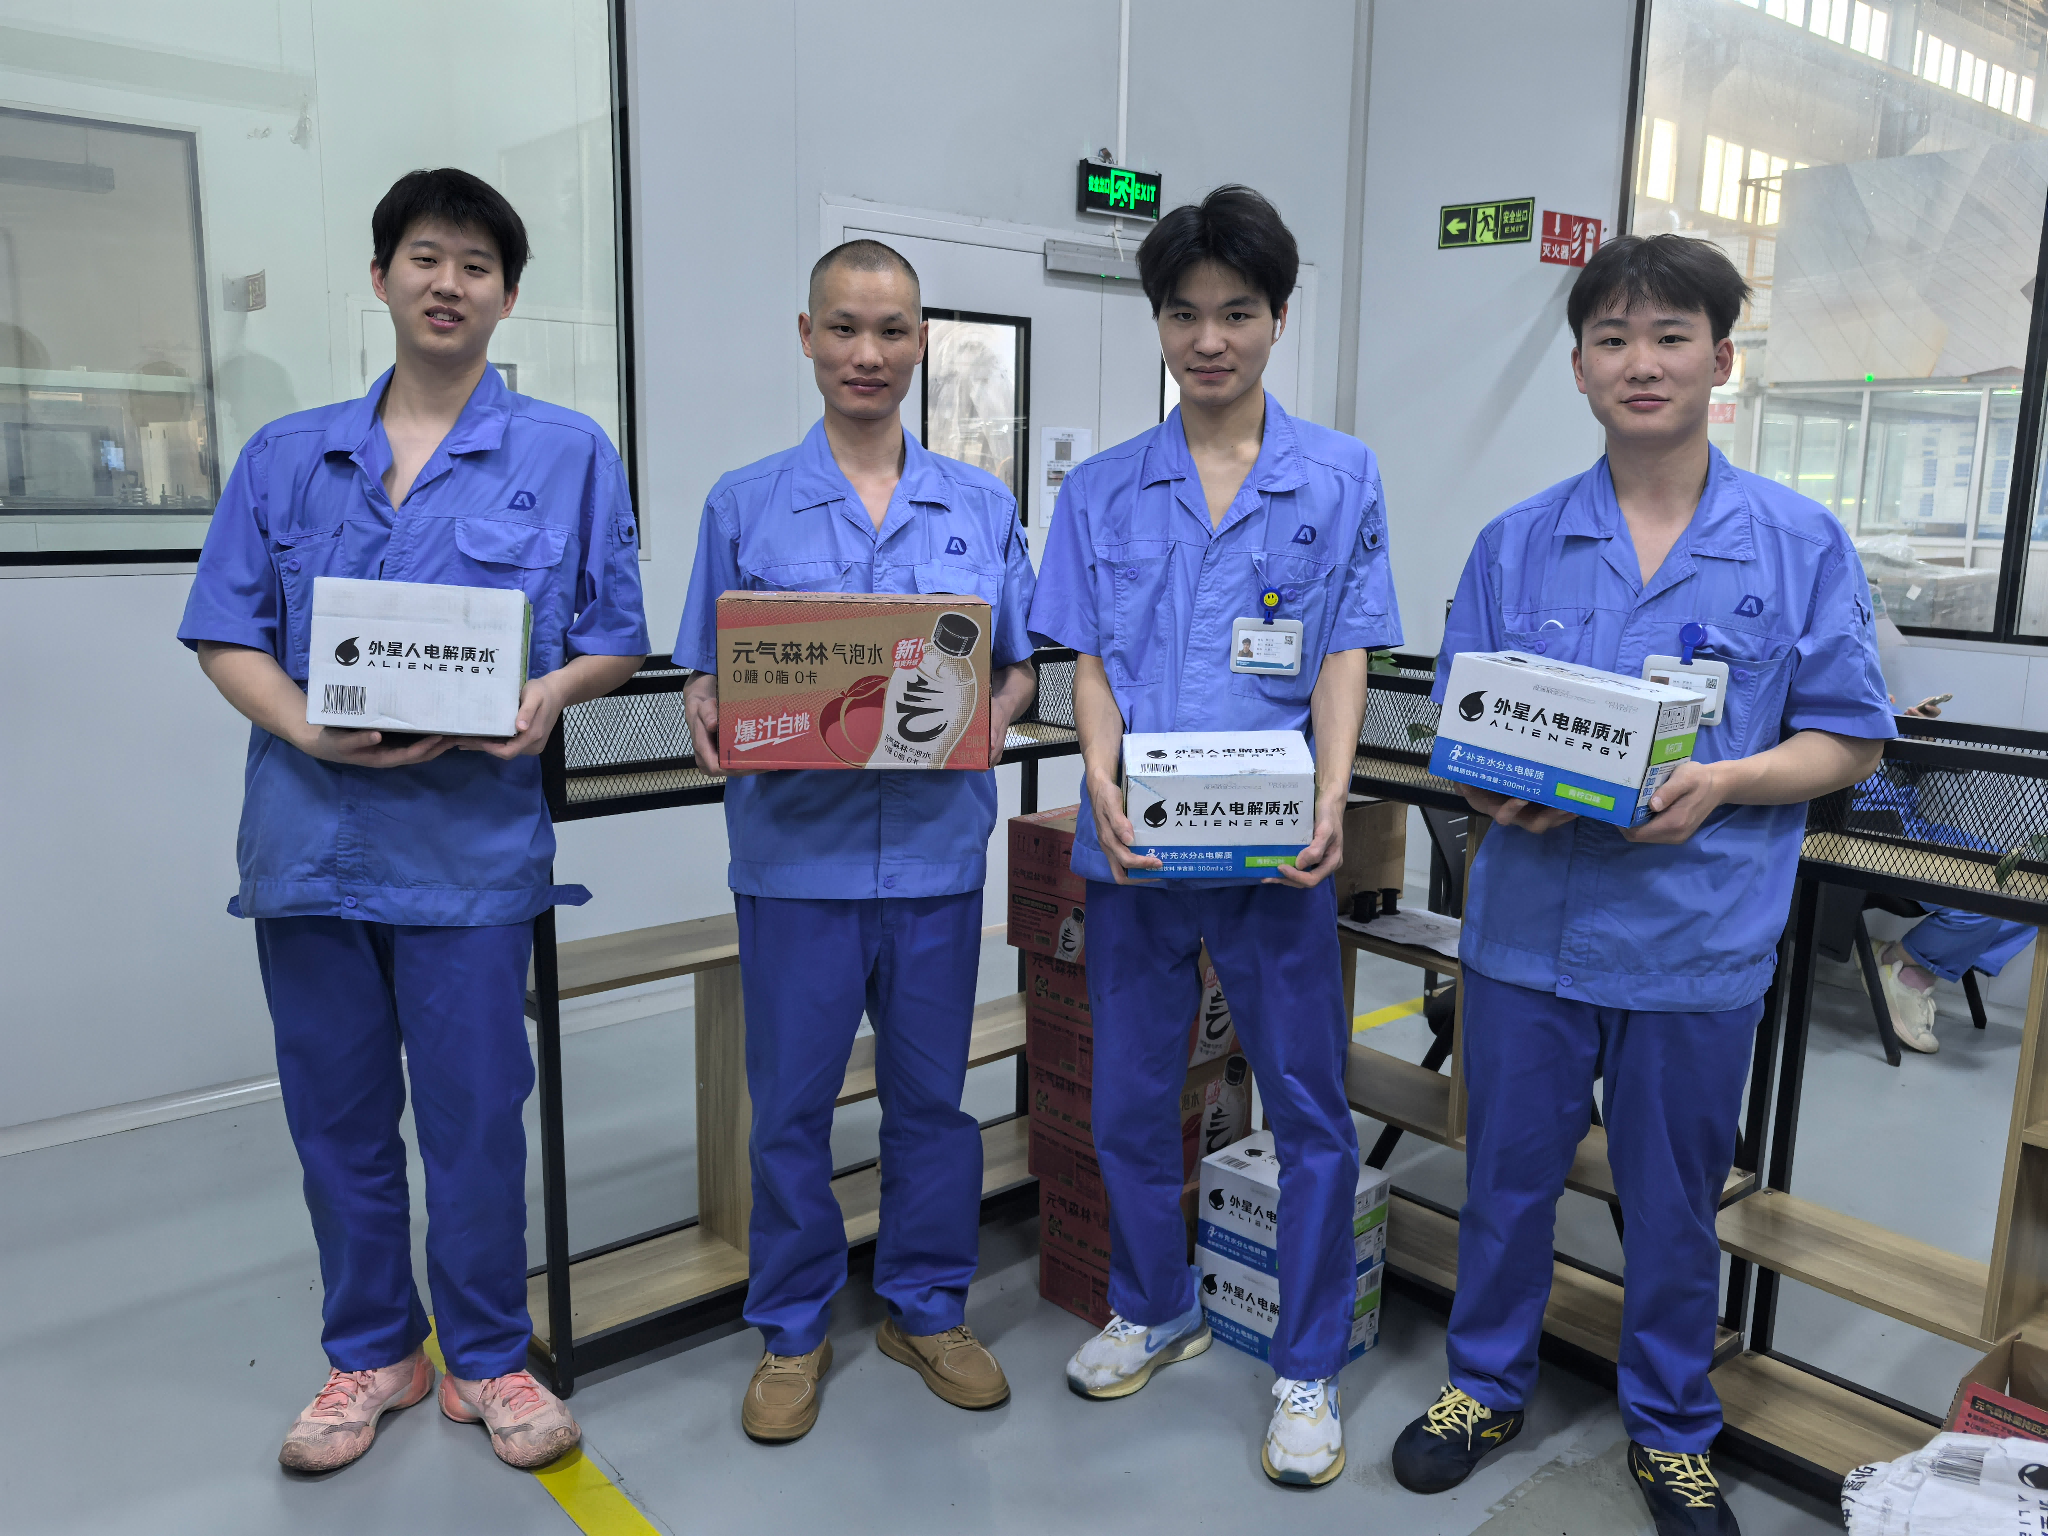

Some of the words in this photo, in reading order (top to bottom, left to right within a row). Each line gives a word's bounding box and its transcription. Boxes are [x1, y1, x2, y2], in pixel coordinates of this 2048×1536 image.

[1135, 183, 1156, 203] EXIT
[1502, 209, 1528, 224] 安全出口
[1504, 224, 1524, 234] EXIT
[1542, 243, 1569, 260] 灭火器
[368, 640, 496, 664] 外星人电解质水
[367, 660, 495, 675] ALIENERGY
[734, 712, 811, 744] 爆汁白桃
[1492, 697, 1631, 748] 外星人电解质水
[1489, 719, 1629, 760] ALIENERGY
[1466, 751, 1545, 781] 补充水分&电解质
[1175, 801, 1300, 816] 外星人电解质水
[1175, 819, 1299, 827] ALIENERGY
[1160, 851, 1233, 860] 补充水分&电解质
